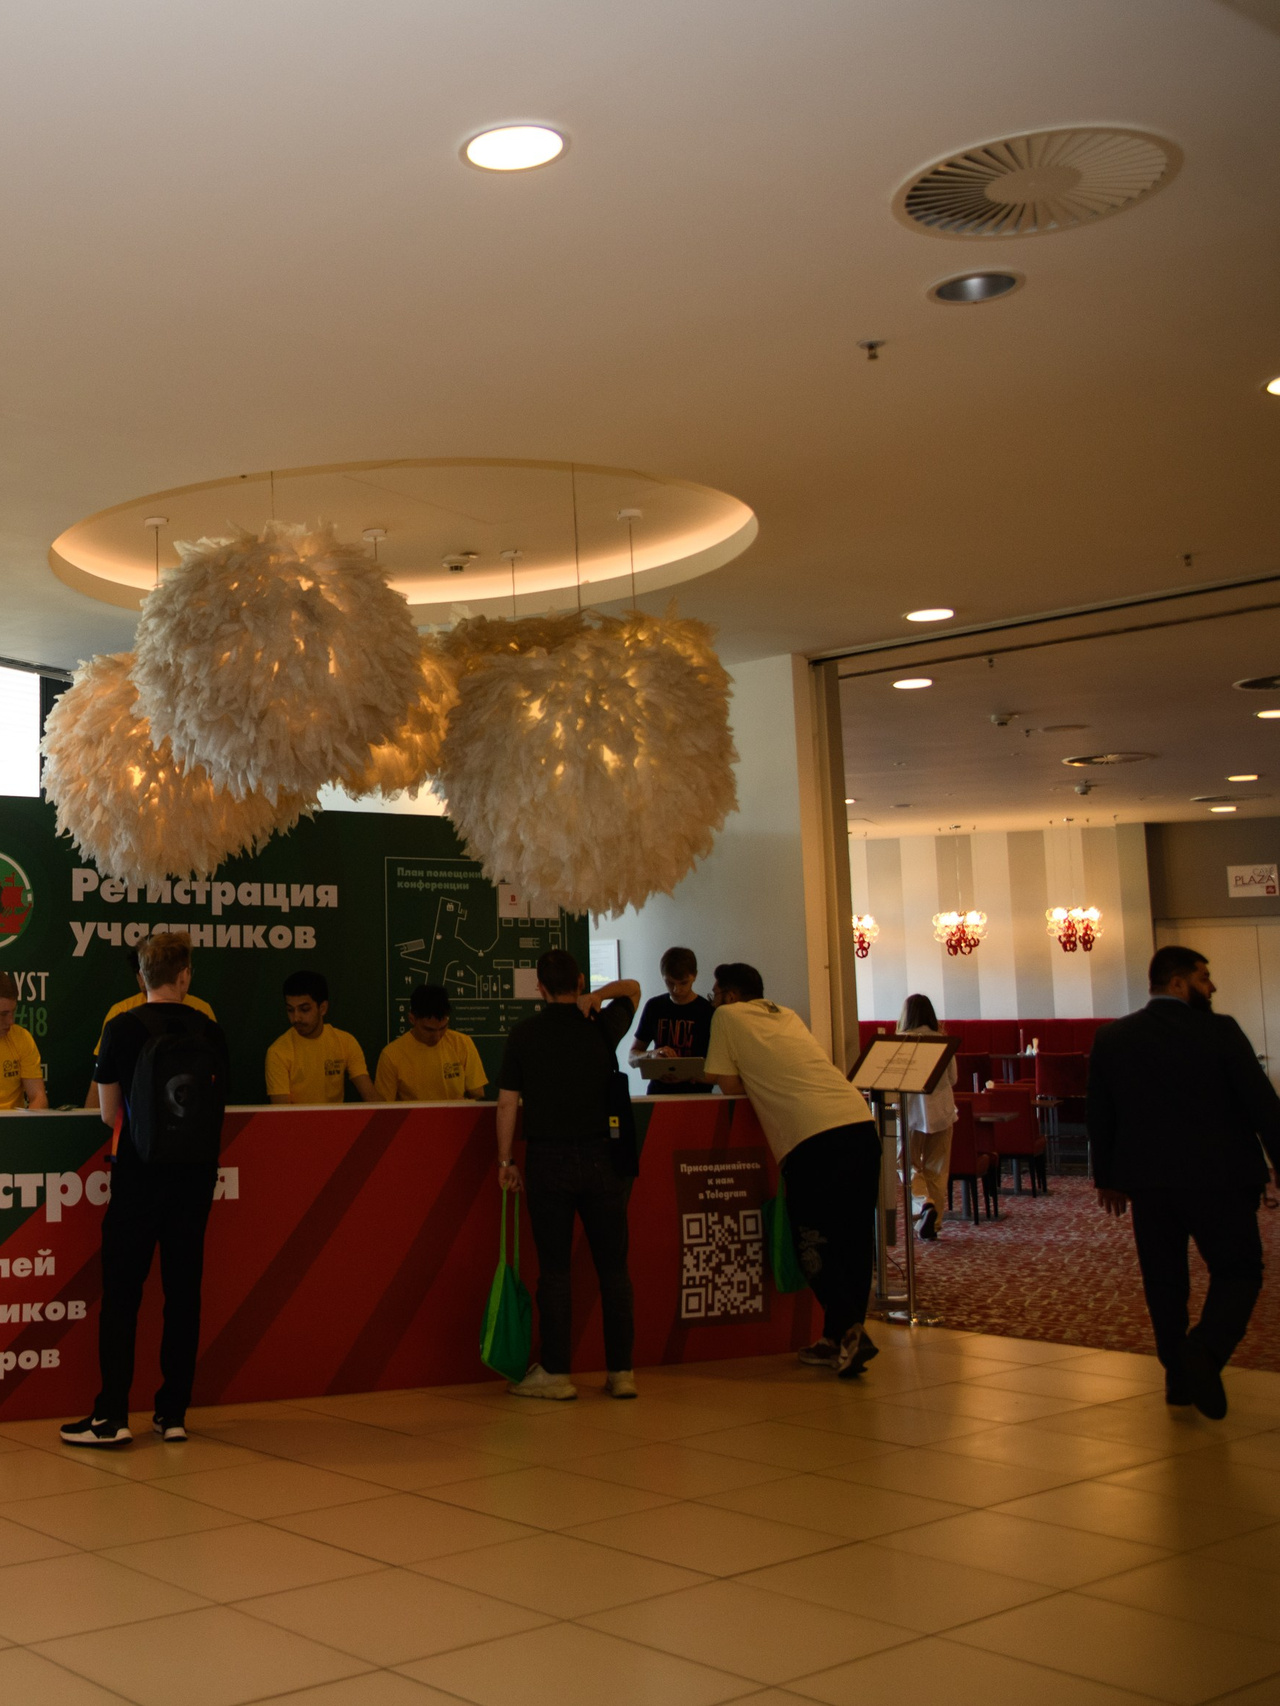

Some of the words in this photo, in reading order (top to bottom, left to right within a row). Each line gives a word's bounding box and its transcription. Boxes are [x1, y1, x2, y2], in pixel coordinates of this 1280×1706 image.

[397, 866, 424, 877] План
[426, 869, 482, 880] помещени
[396, 879, 470, 892] конференции
[1234, 874, 1276, 887] PLAZA
[71, 867, 339, 916] Регистрация
[14, 1004, 48, 1037] #18
[680, 1160, 761, 1176] Присоединяйтесь
[706, 1178, 714, 1186] к
[715, 1177, 735, 1186] нам
[698, 1192, 705, 1200] в
[705, 1188, 748, 1202] Telegram
